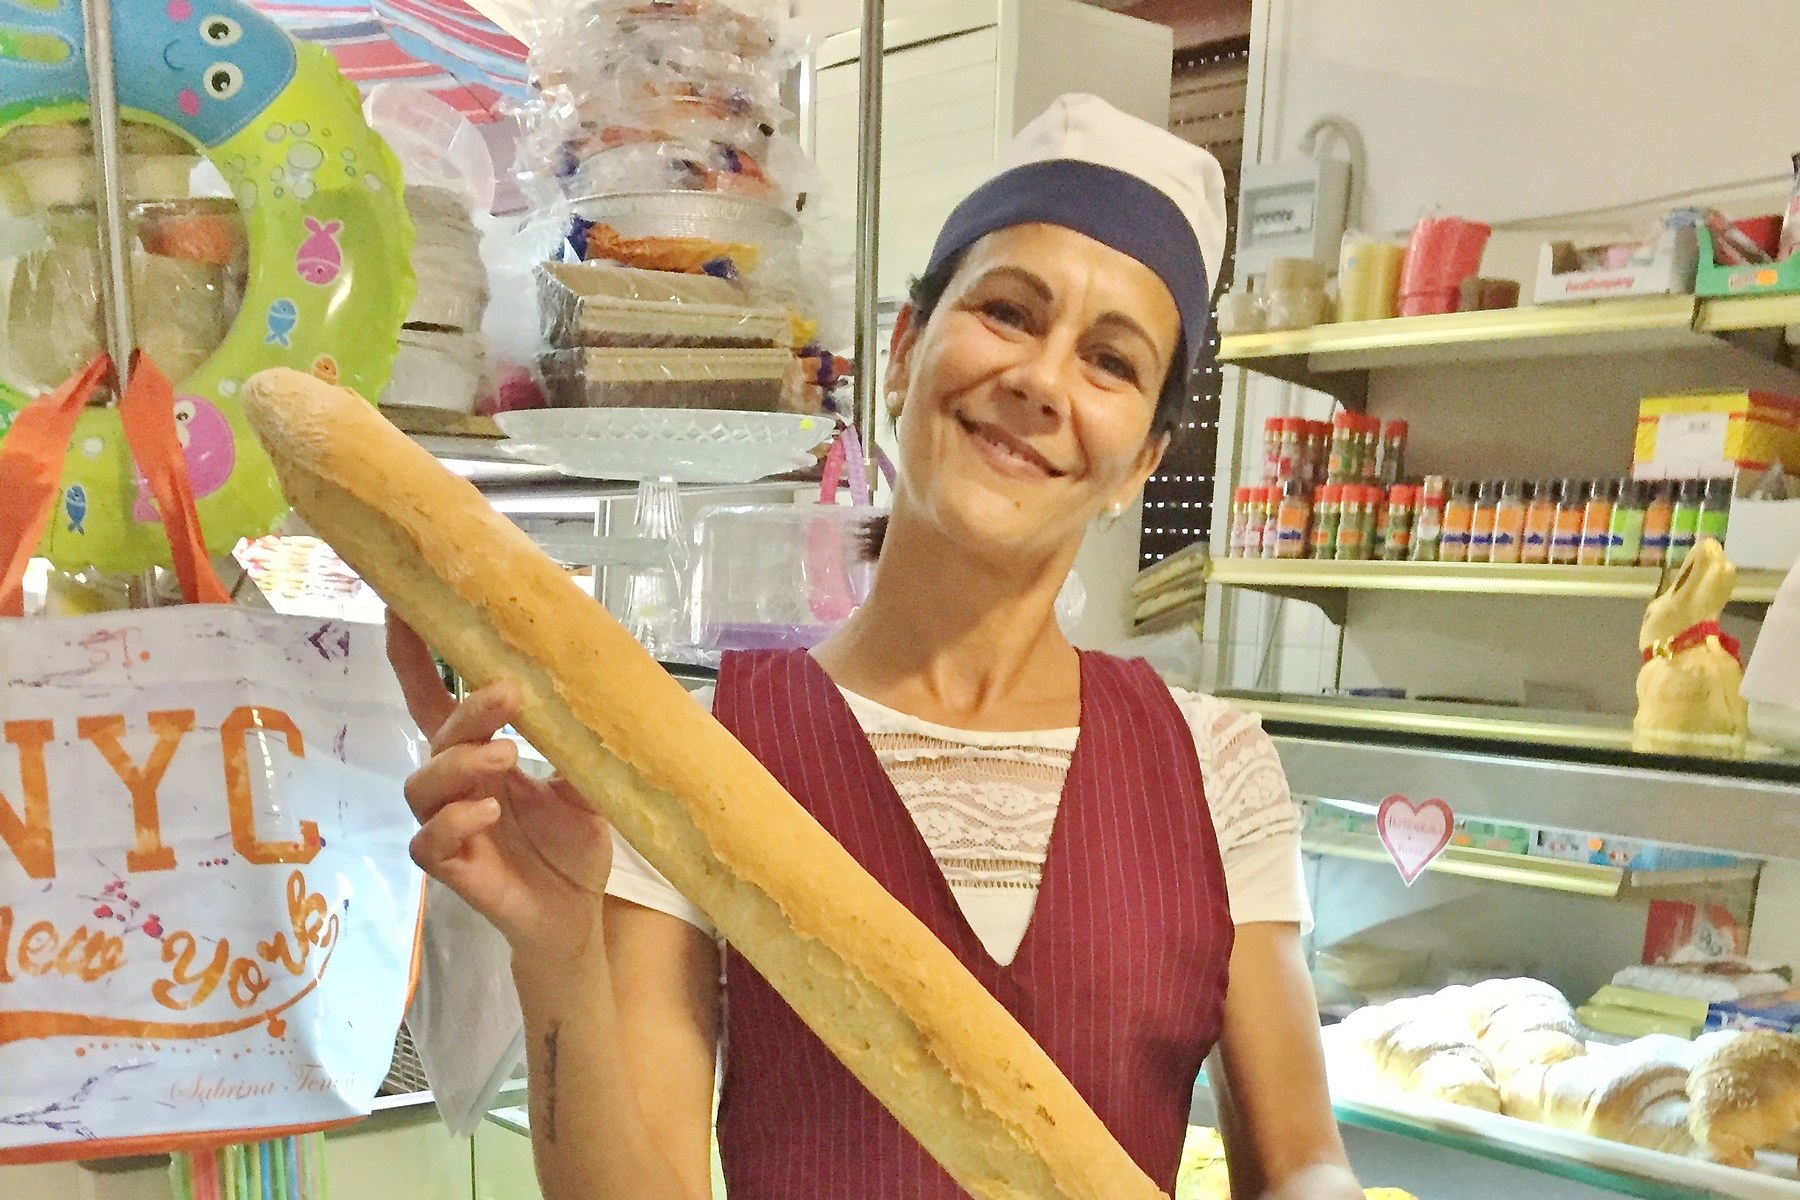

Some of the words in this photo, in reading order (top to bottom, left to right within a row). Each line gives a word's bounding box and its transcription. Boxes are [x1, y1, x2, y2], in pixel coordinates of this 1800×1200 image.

[0, 905, 128, 983] ew
[152, 869, 332, 1010] York
[170, 1073, 275, 1101] Sabrina
